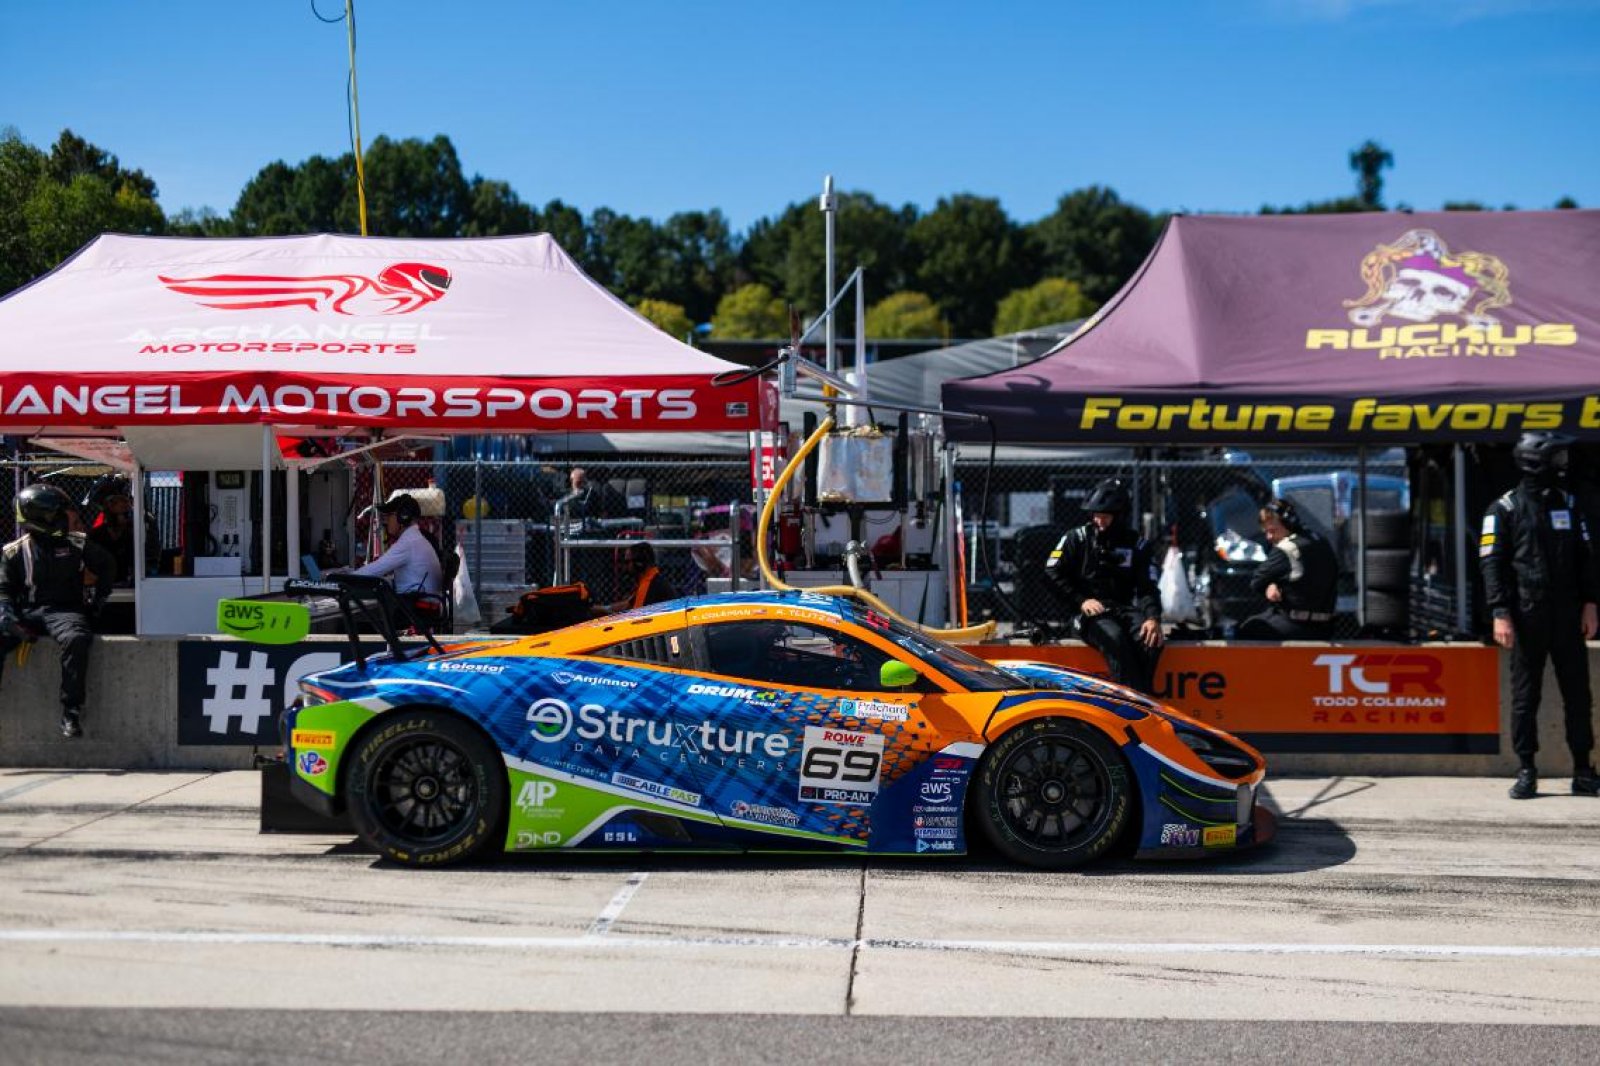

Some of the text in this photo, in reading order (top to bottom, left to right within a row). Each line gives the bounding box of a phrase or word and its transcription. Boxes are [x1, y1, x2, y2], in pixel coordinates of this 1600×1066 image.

[120, 322, 447, 342] ARCHANGEL
[1306, 323, 1577, 350] RUCKUS
[139, 341, 416, 354] MOTORSPORTS
[1379, 344, 1516, 360] RACING
[0, 384, 202, 415] ANGEL
[217, 384, 697, 420] MOTORSPORTS
[1079, 398, 1335, 431] Fortune
[1348, 399, 1563, 431] favors
[224, 604, 263, 619] aws
[1312, 654, 1445, 693] TCR
[687, 684, 757, 700] DRUM
[858, 701, 907, 714] Pritchard
[1312, 696, 1447, 707] TODD COLEMAN
[1312, 711, 1446, 723] RACING
[823, 730, 866, 744] ROWE
[574, 742, 784, 772] DATA CENTERS
[802, 746, 880, 783] 69
[921, 782, 951, 794] aws
[823, 790, 870, 803] PRO-AM
